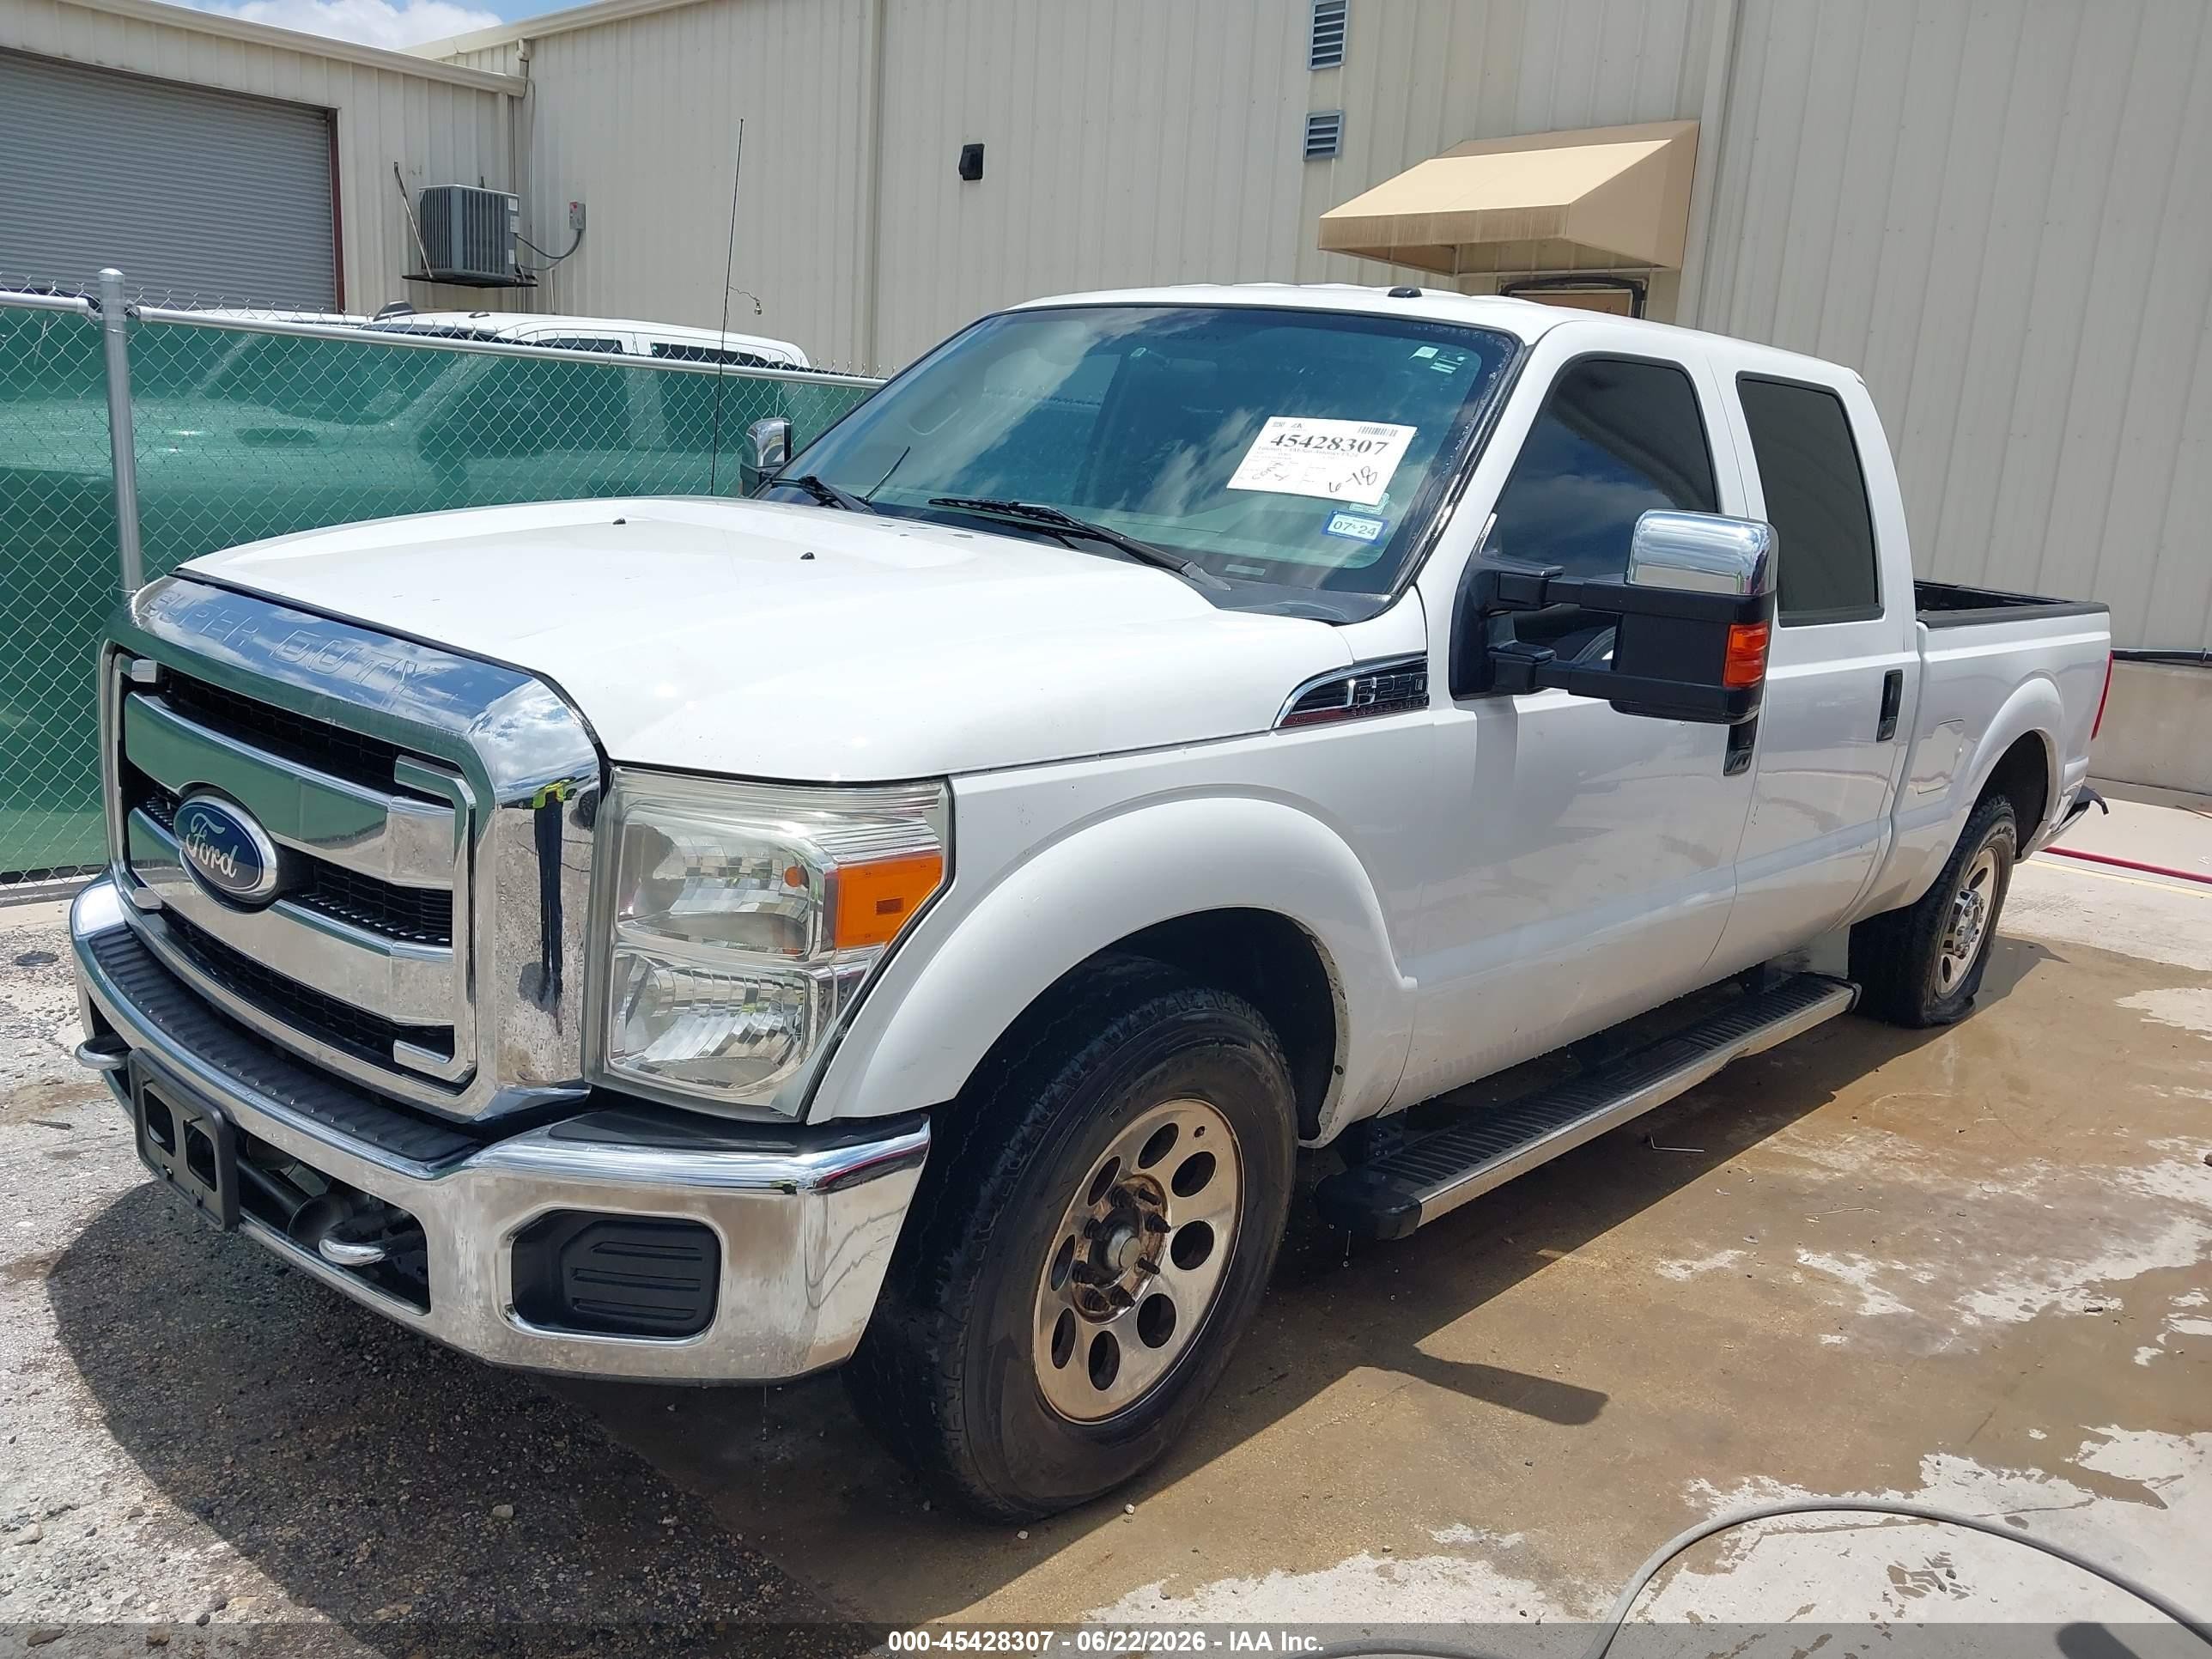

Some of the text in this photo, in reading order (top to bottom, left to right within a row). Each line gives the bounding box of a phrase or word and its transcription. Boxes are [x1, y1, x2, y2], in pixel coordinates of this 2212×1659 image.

[1270, 433, 1389, 455] 45428307
[143, 592, 449, 708] SUPER DUTY
[185, 812, 239, 878] Ford
